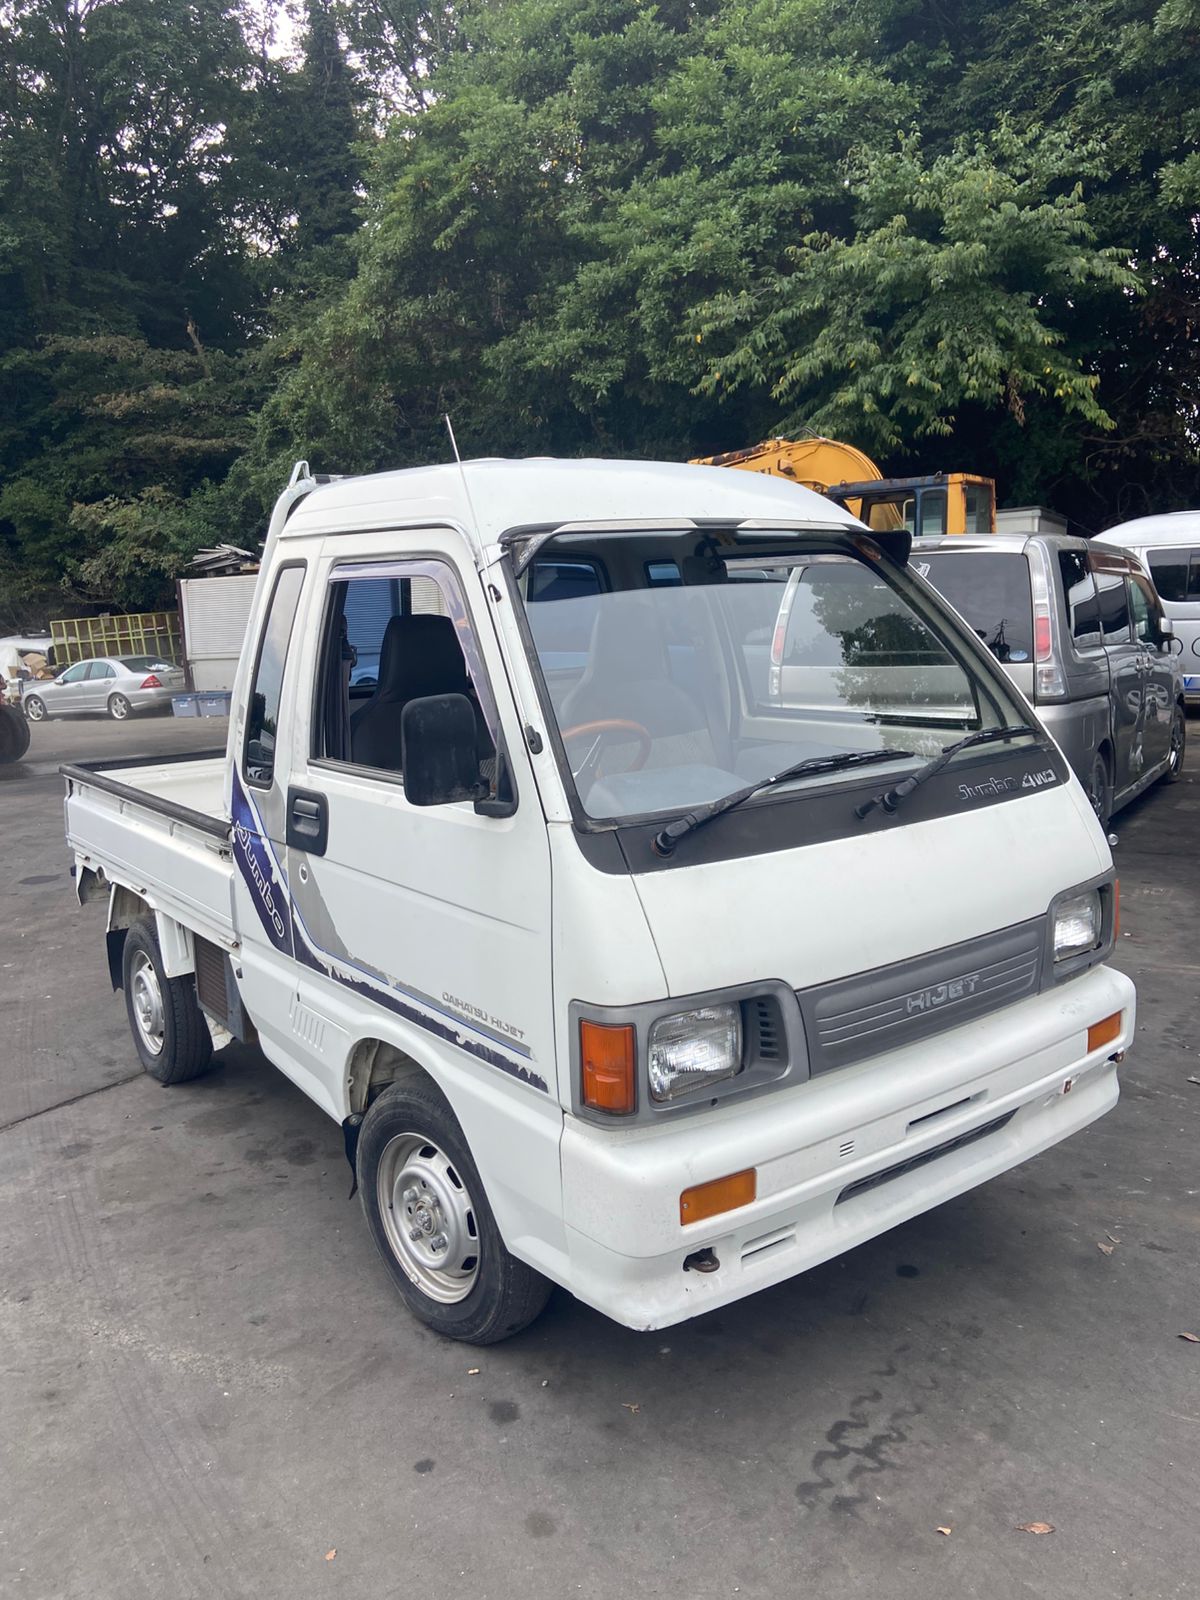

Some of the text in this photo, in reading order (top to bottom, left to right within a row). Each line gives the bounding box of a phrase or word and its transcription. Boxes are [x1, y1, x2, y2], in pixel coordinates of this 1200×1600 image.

[1021, 769, 1057, 788] 4WD
[235, 820, 285, 938] Jumbo
[442, 991, 525, 1039] DAIHATSU HIJET
[907, 974, 980, 1013] HIJET
